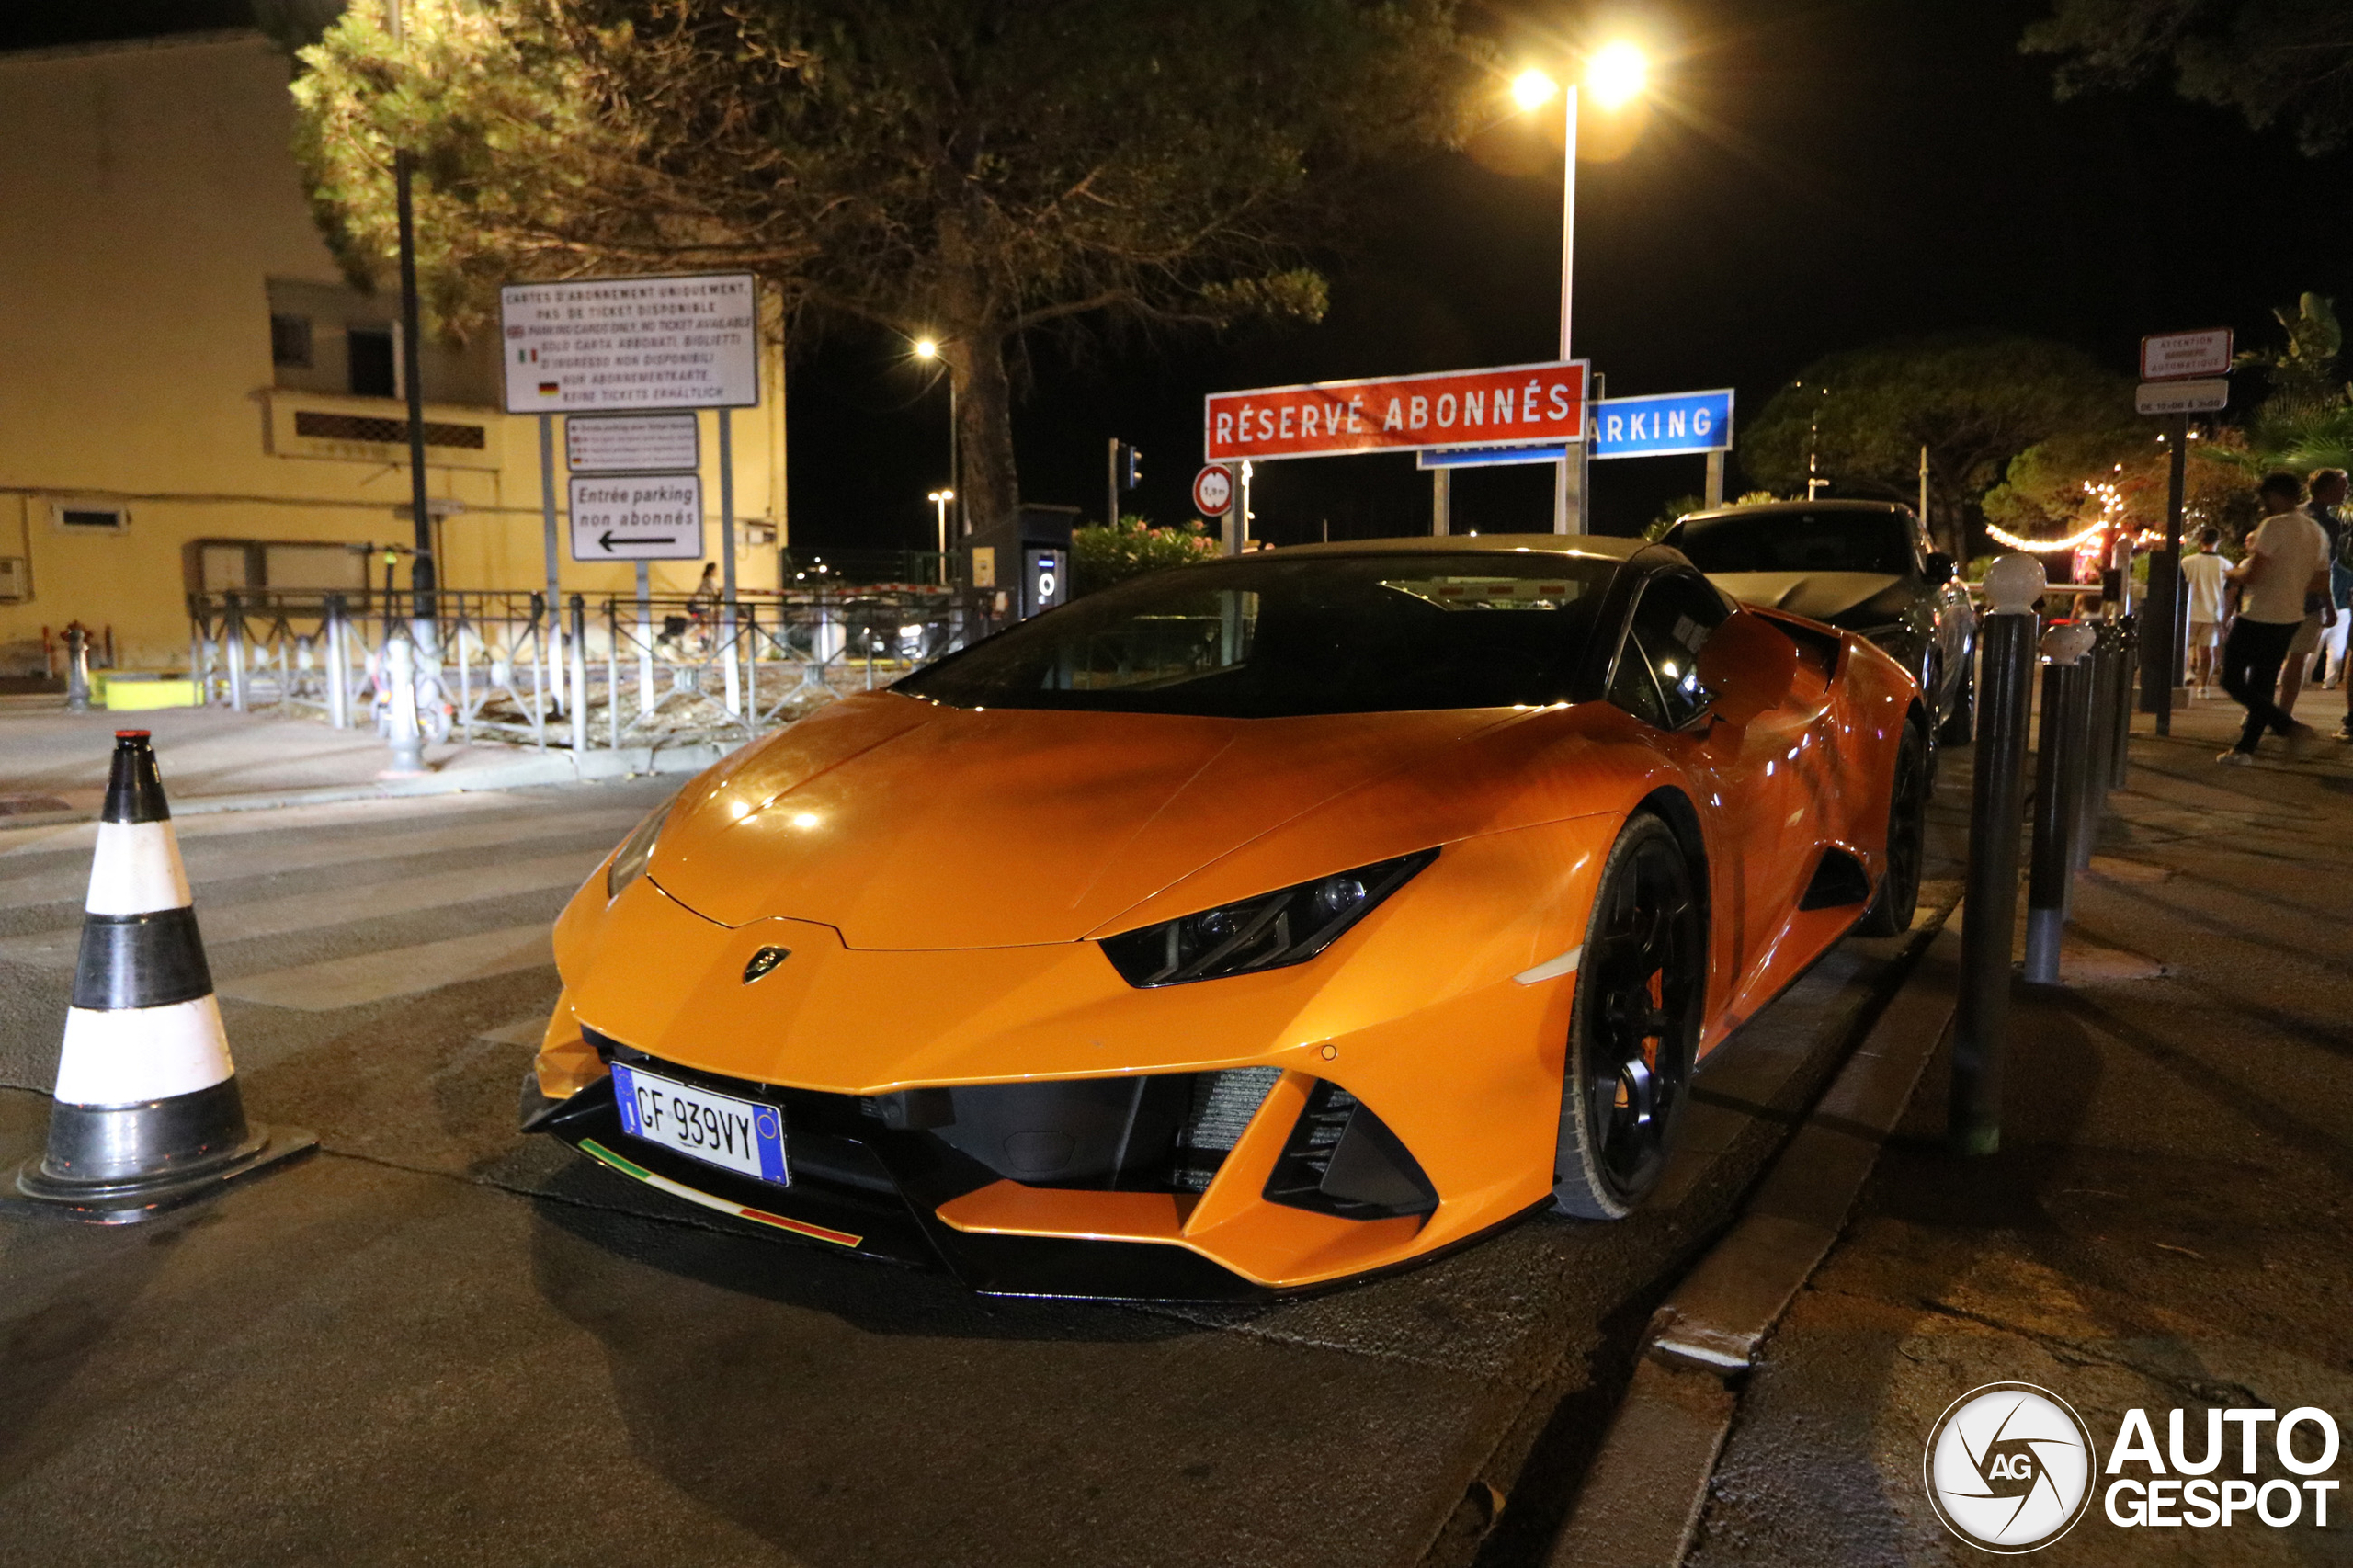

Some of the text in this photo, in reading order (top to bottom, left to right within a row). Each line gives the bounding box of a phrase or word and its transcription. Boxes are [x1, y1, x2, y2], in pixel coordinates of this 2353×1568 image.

[568, 307, 583, 319] DE
[2160, 336, 2213, 348] ATTENTION
[2151, 358, 2219, 372] AUTOMATIQUE
[1216, 379, 1570, 444] RÉSERVÉ ABONNÉS
[1588, 407, 1711, 443] ARKING
[578, 485, 693, 506] Entrée parking
[579, 508, 694, 527] non abonnés
